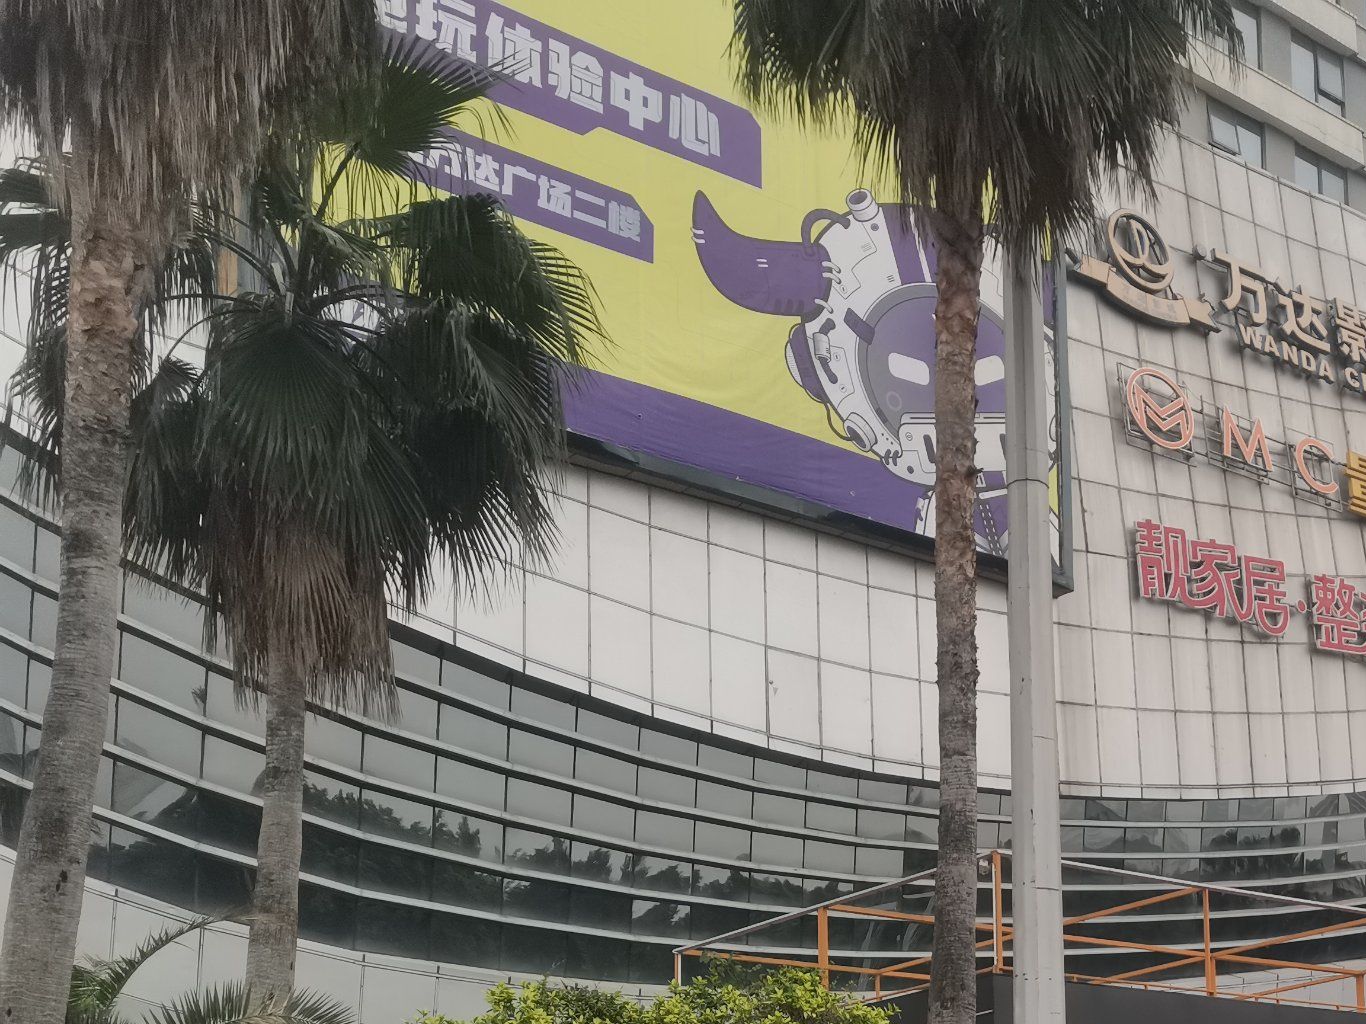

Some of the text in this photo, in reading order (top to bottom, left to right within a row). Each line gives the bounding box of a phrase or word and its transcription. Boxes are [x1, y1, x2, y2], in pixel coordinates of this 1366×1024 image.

[408, 137, 641, 243] 万达广场二楼
[1239, 323, 1335, 384] WANDA
